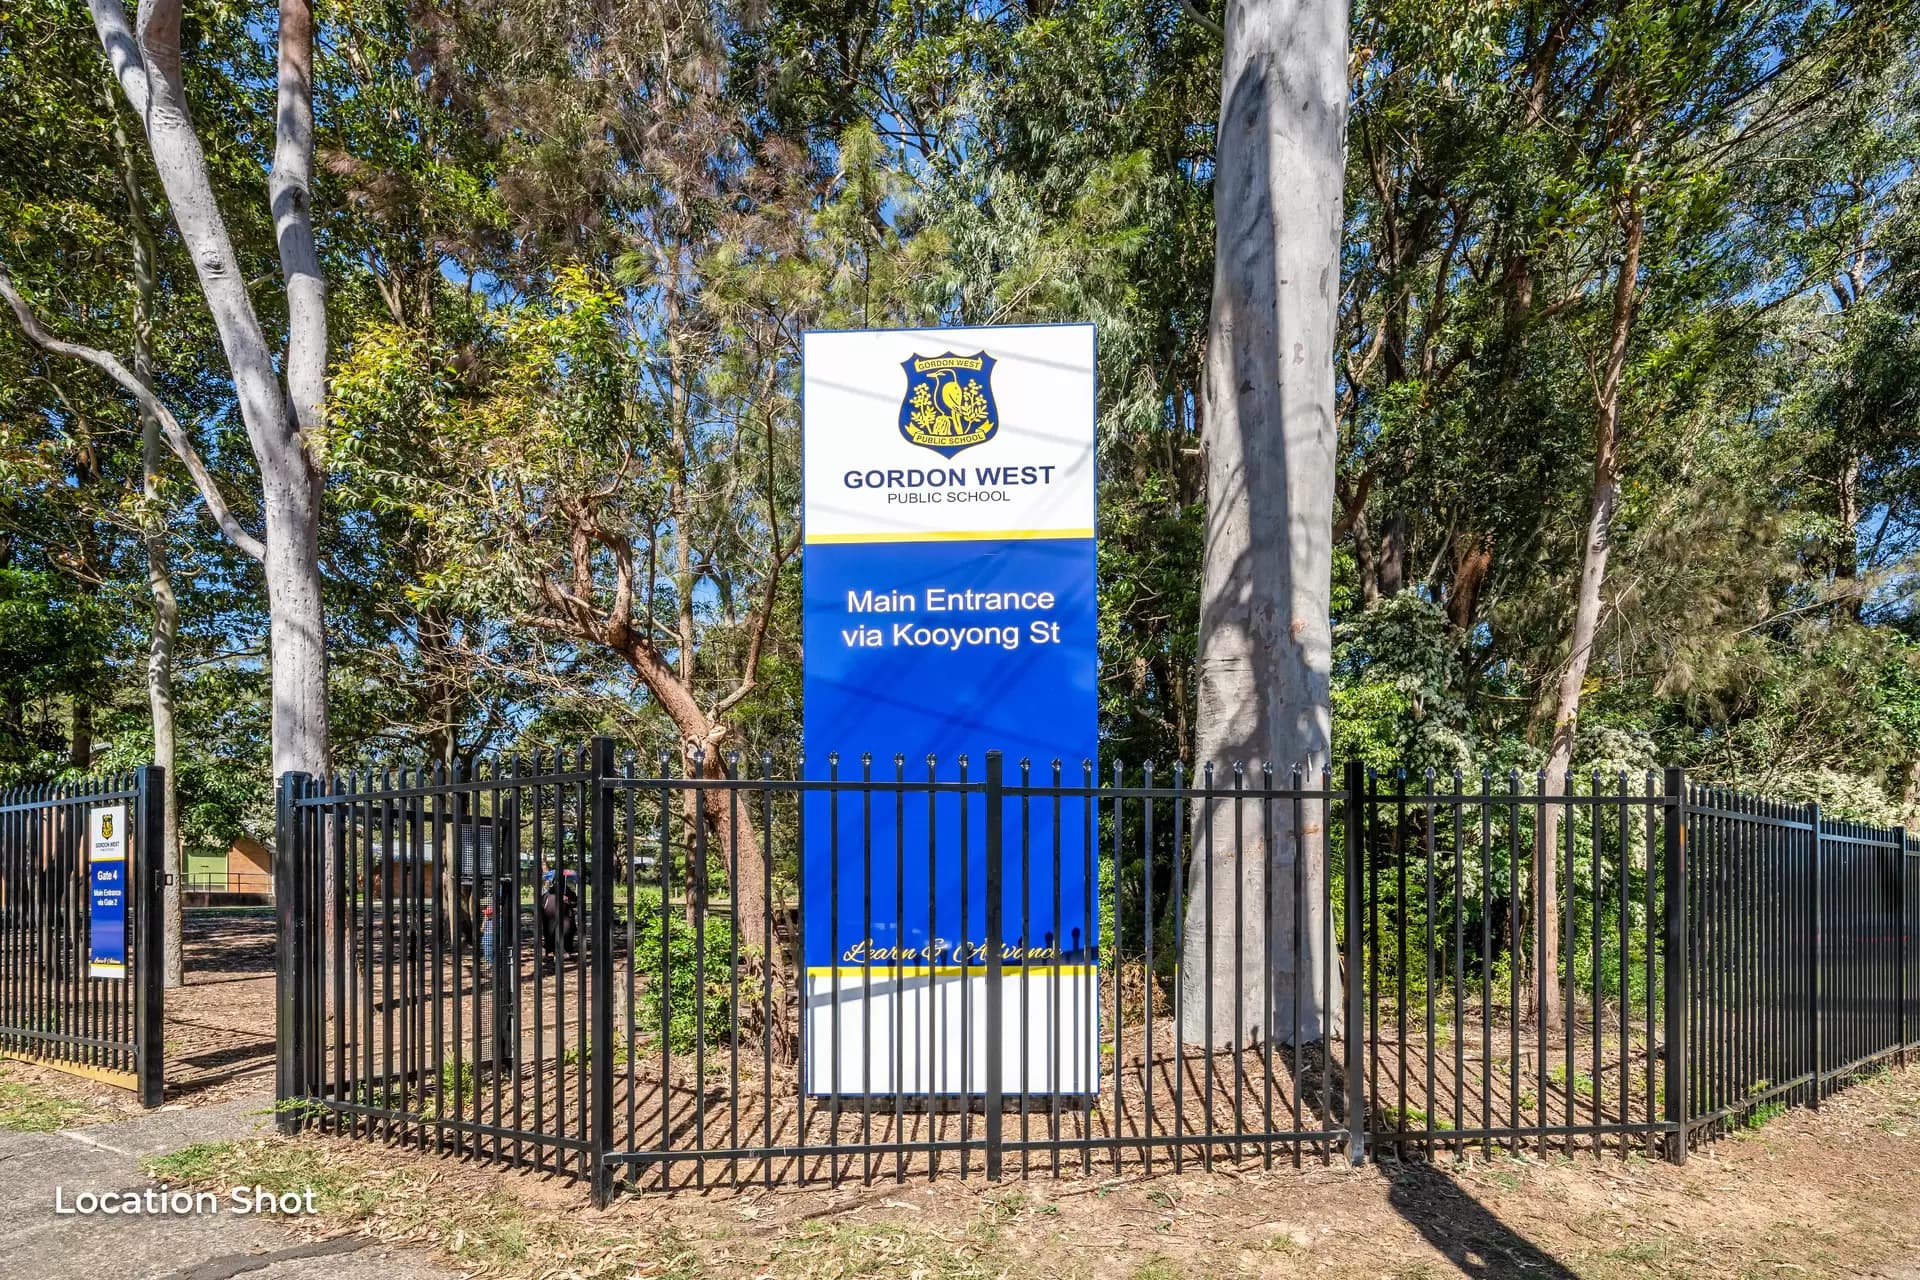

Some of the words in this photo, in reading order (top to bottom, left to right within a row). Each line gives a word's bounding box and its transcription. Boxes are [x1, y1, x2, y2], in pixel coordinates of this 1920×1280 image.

[918, 359, 954, 370] GORDON
[956, 359, 981, 369] WEST
[916, 434, 947, 445] PUBLIC
[948, 433, 984, 444] SCHOOL
[844, 468, 966, 489] GORDON
[976, 466, 1055, 485] WEST
[887, 493, 942, 504] PUBLIC
[947, 490, 1011, 503] SCHOOL
[848, 590, 915, 613] Main
[926, 588, 1055, 611] Entrance
[842, 625, 883, 647] via
[893, 623, 1019, 650] Kooyong
[1029, 621, 1060, 643] St
[97, 870, 112, 880] Gate
[112, 870, 118, 880] 4
[843, 939, 917, 963] Learn
[952, 937, 1062, 963] Avanc
